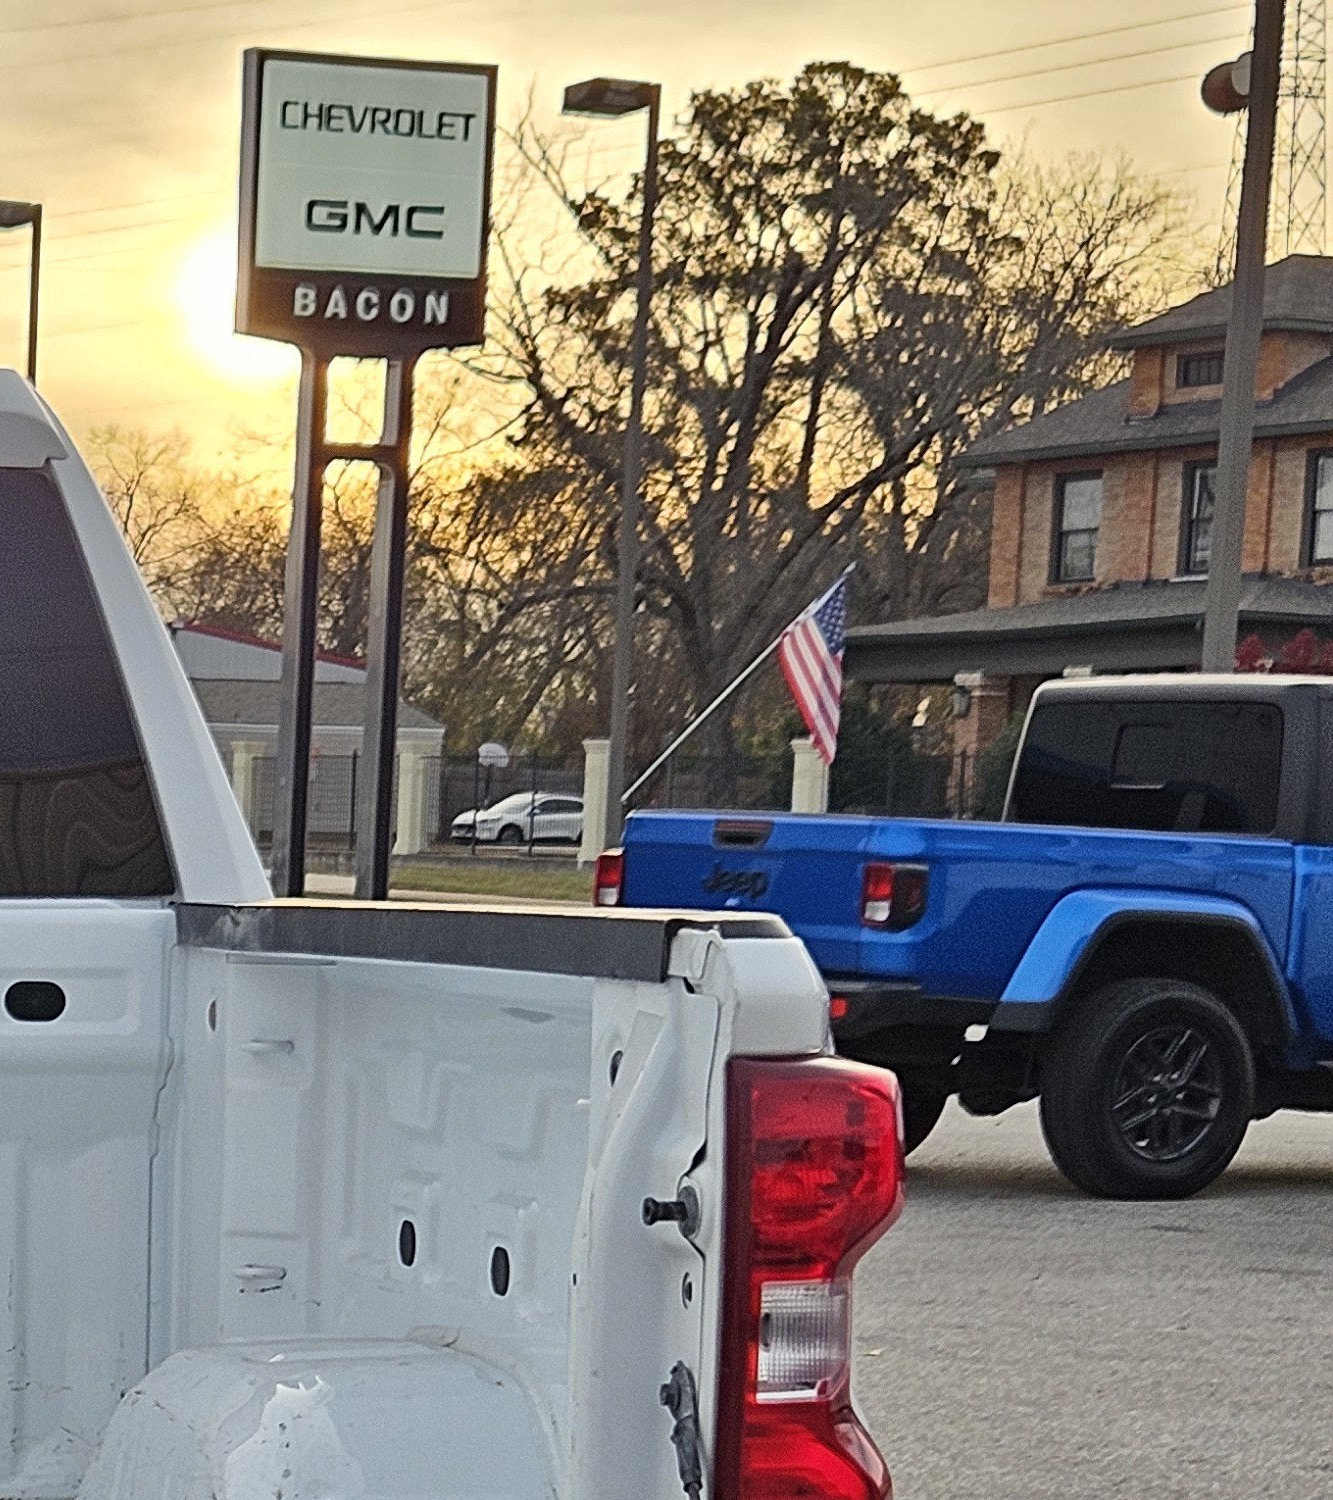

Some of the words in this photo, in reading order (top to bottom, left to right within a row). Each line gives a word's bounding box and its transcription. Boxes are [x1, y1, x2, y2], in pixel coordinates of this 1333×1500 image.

[280, 101, 476, 142] CHEVROLET
[306, 199, 445, 239] GMC
[293, 284, 449, 325] BACON
[703, 862, 768, 899] Jeep
